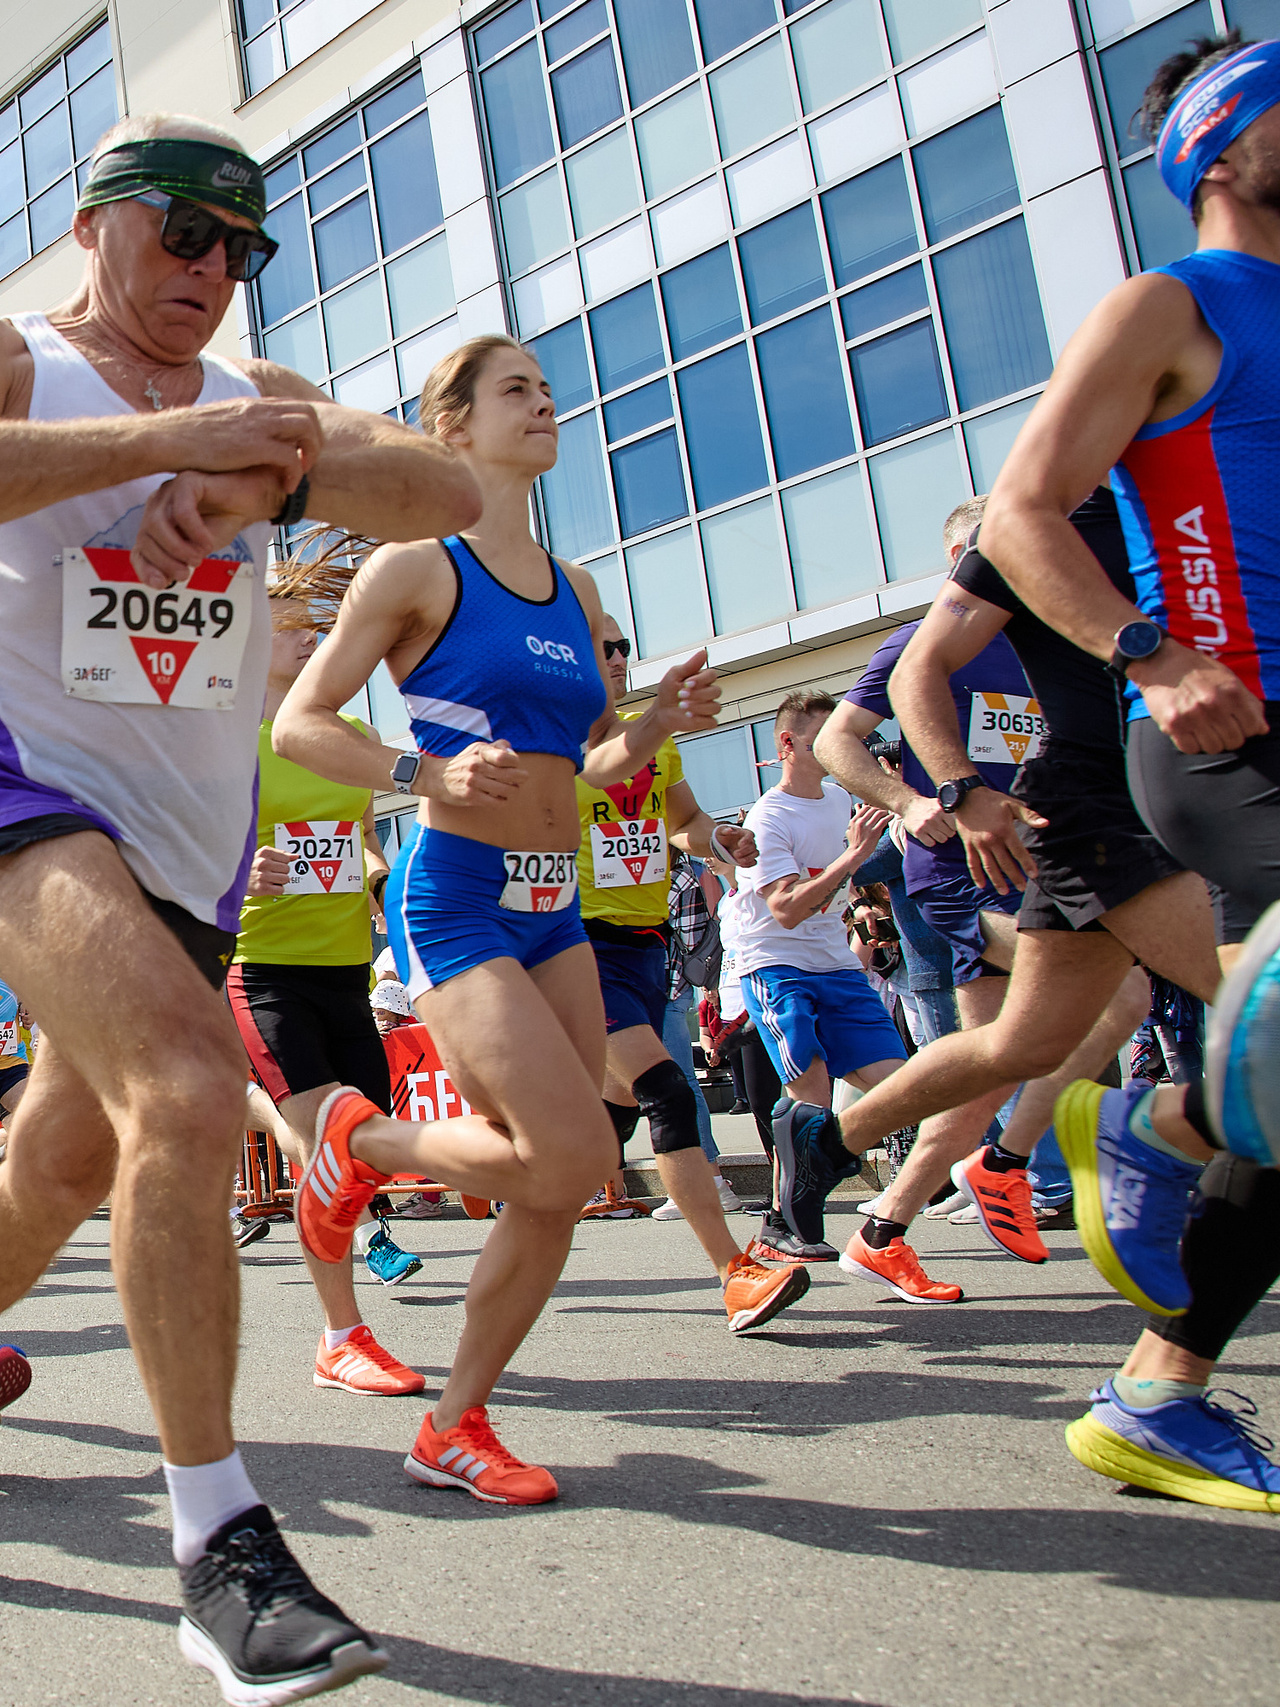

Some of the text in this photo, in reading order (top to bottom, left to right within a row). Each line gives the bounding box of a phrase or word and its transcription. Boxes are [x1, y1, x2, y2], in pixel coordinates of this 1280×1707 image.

[220, 161, 252, 185] RUN
[87, 587, 234, 639] 20649
[525, 635, 579, 665] OCR
[147, 651, 176, 676] 10
[534, 662, 584, 682] RUSSIA
[982, 711, 1045, 736] 30633
[1008, 741, 1026, 752] 21,1
[593, 791, 663, 823] RUN
[287, 838, 354, 860] 20271
[602, 836, 661, 859] 20342
[319, 866, 334, 879] 10
[630, 862, 641, 873] 10
[536, 896, 551, 912] 10
